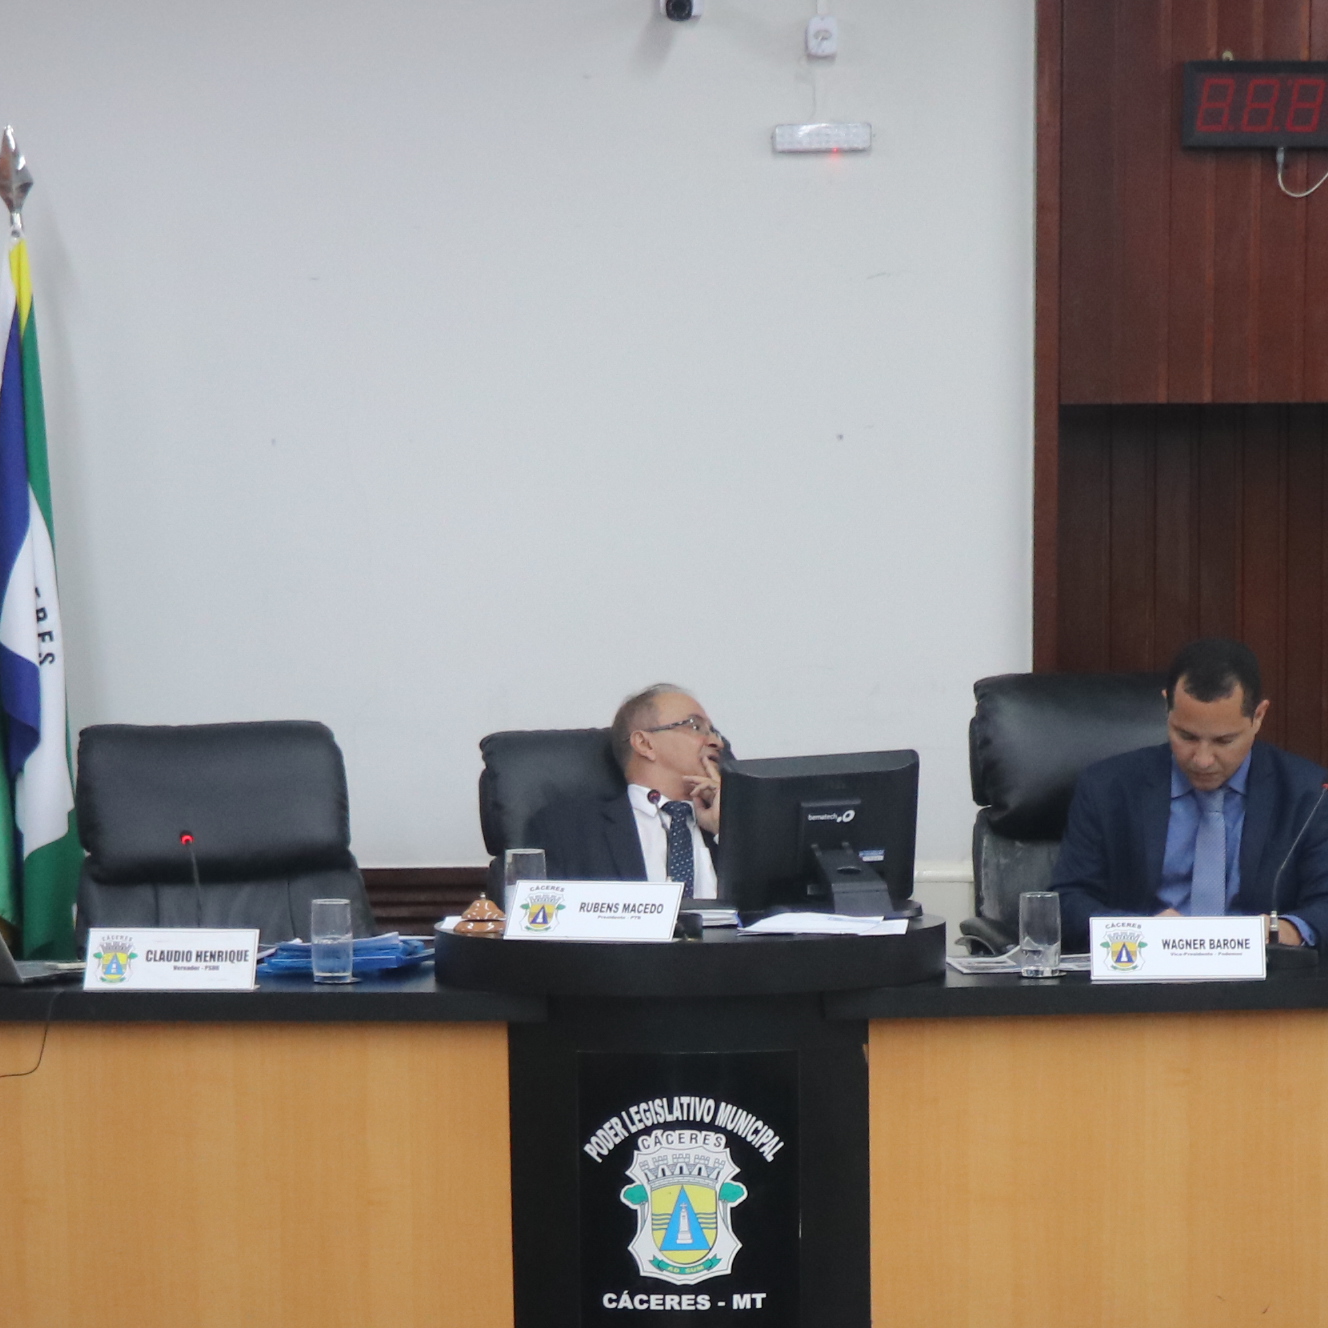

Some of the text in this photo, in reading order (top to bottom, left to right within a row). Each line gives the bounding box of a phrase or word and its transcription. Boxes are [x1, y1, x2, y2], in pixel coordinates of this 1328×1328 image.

[807, 812, 838, 821] bematech
[579, 902, 664, 914] RUBENS MACEDO
[1162, 938, 1250, 950] WAGNER BARONE
[145, 950, 249, 964] CLAUDIO HENRIQUE
[583, 1096, 785, 1163] PODER LEGISLATIVO MUNICIPAL
[640, 1131, 724, 1151] CÁCERES
[602, 1291, 711, 1311] CÁCERES
[732, 1293, 767, 1310] MT
